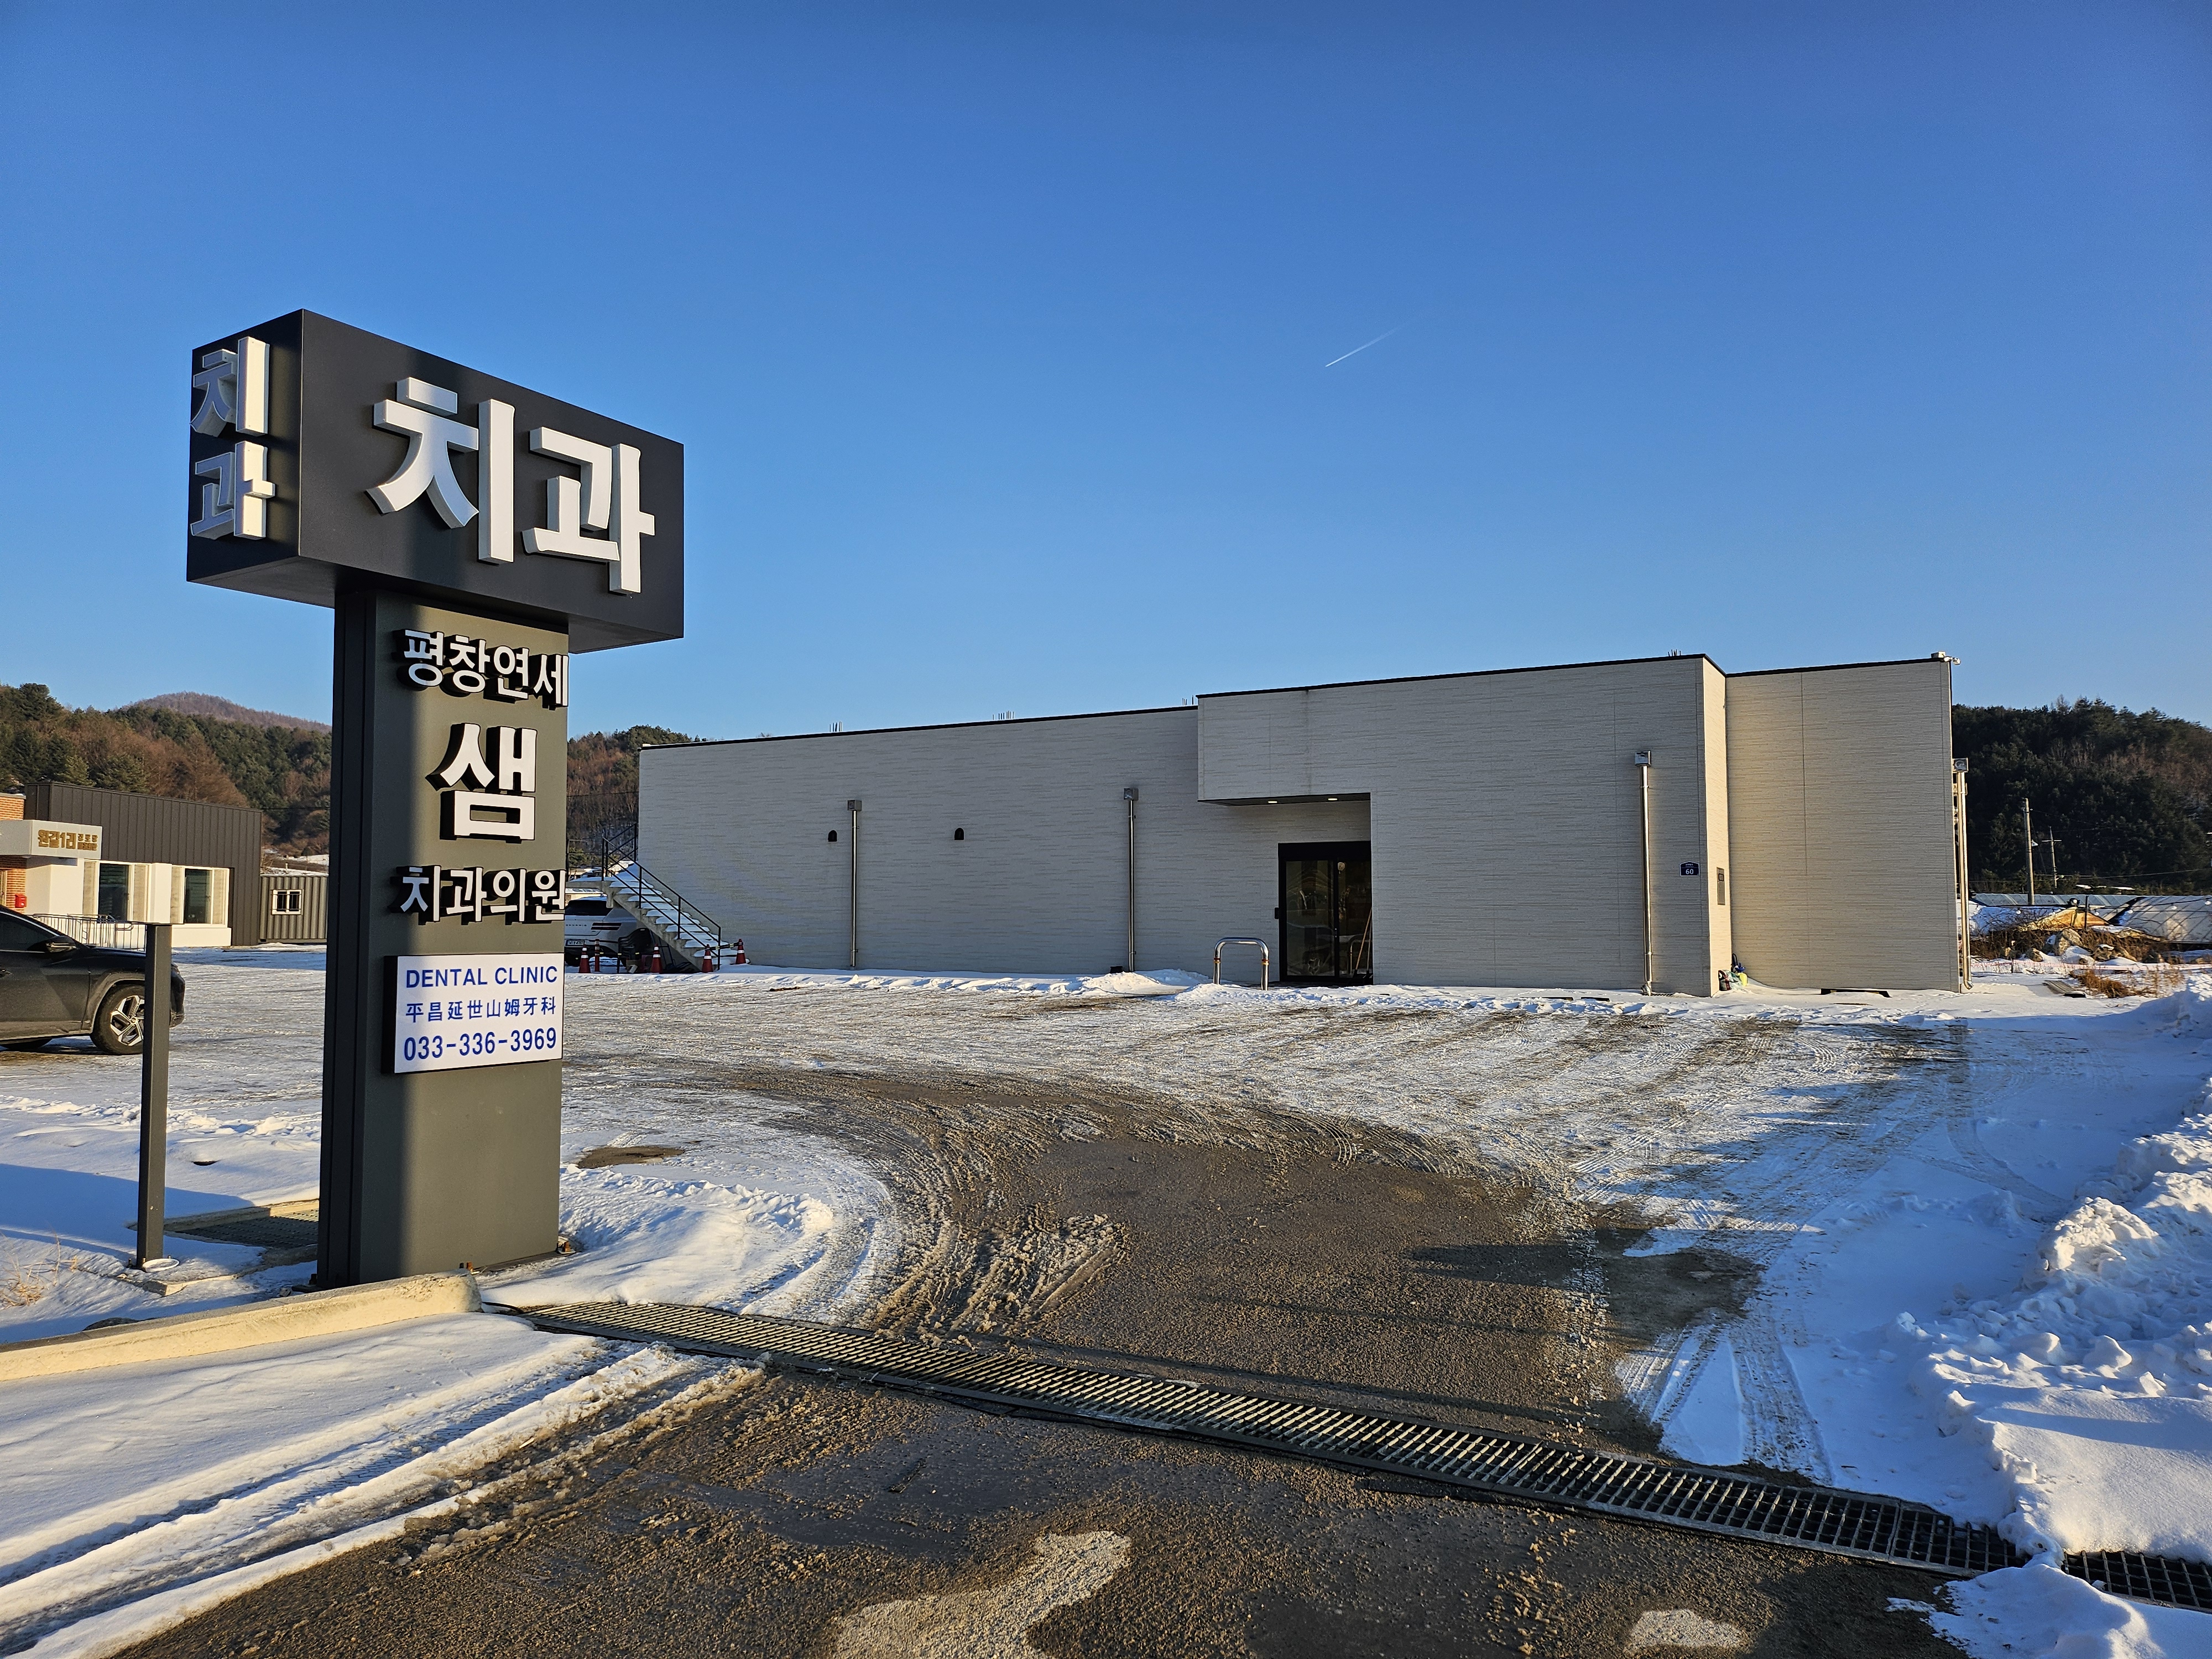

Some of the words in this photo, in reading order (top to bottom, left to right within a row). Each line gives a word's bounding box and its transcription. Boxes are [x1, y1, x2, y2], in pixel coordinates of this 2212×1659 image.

[190, 336, 275, 540] 치과
[366, 377, 655, 594] 치과
[403, 629, 569, 707] 평창연세
[437, 722, 538, 841] 샘
[399, 865, 566, 922] 치과의원
[405, 996, 556, 1023] 平昌延世山姆牙科
[406, 968, 488, 989] DENTAL
[494, 966, 558, 984] CLINIC
[404, 1027, 556, 1061] 033-336-3969
